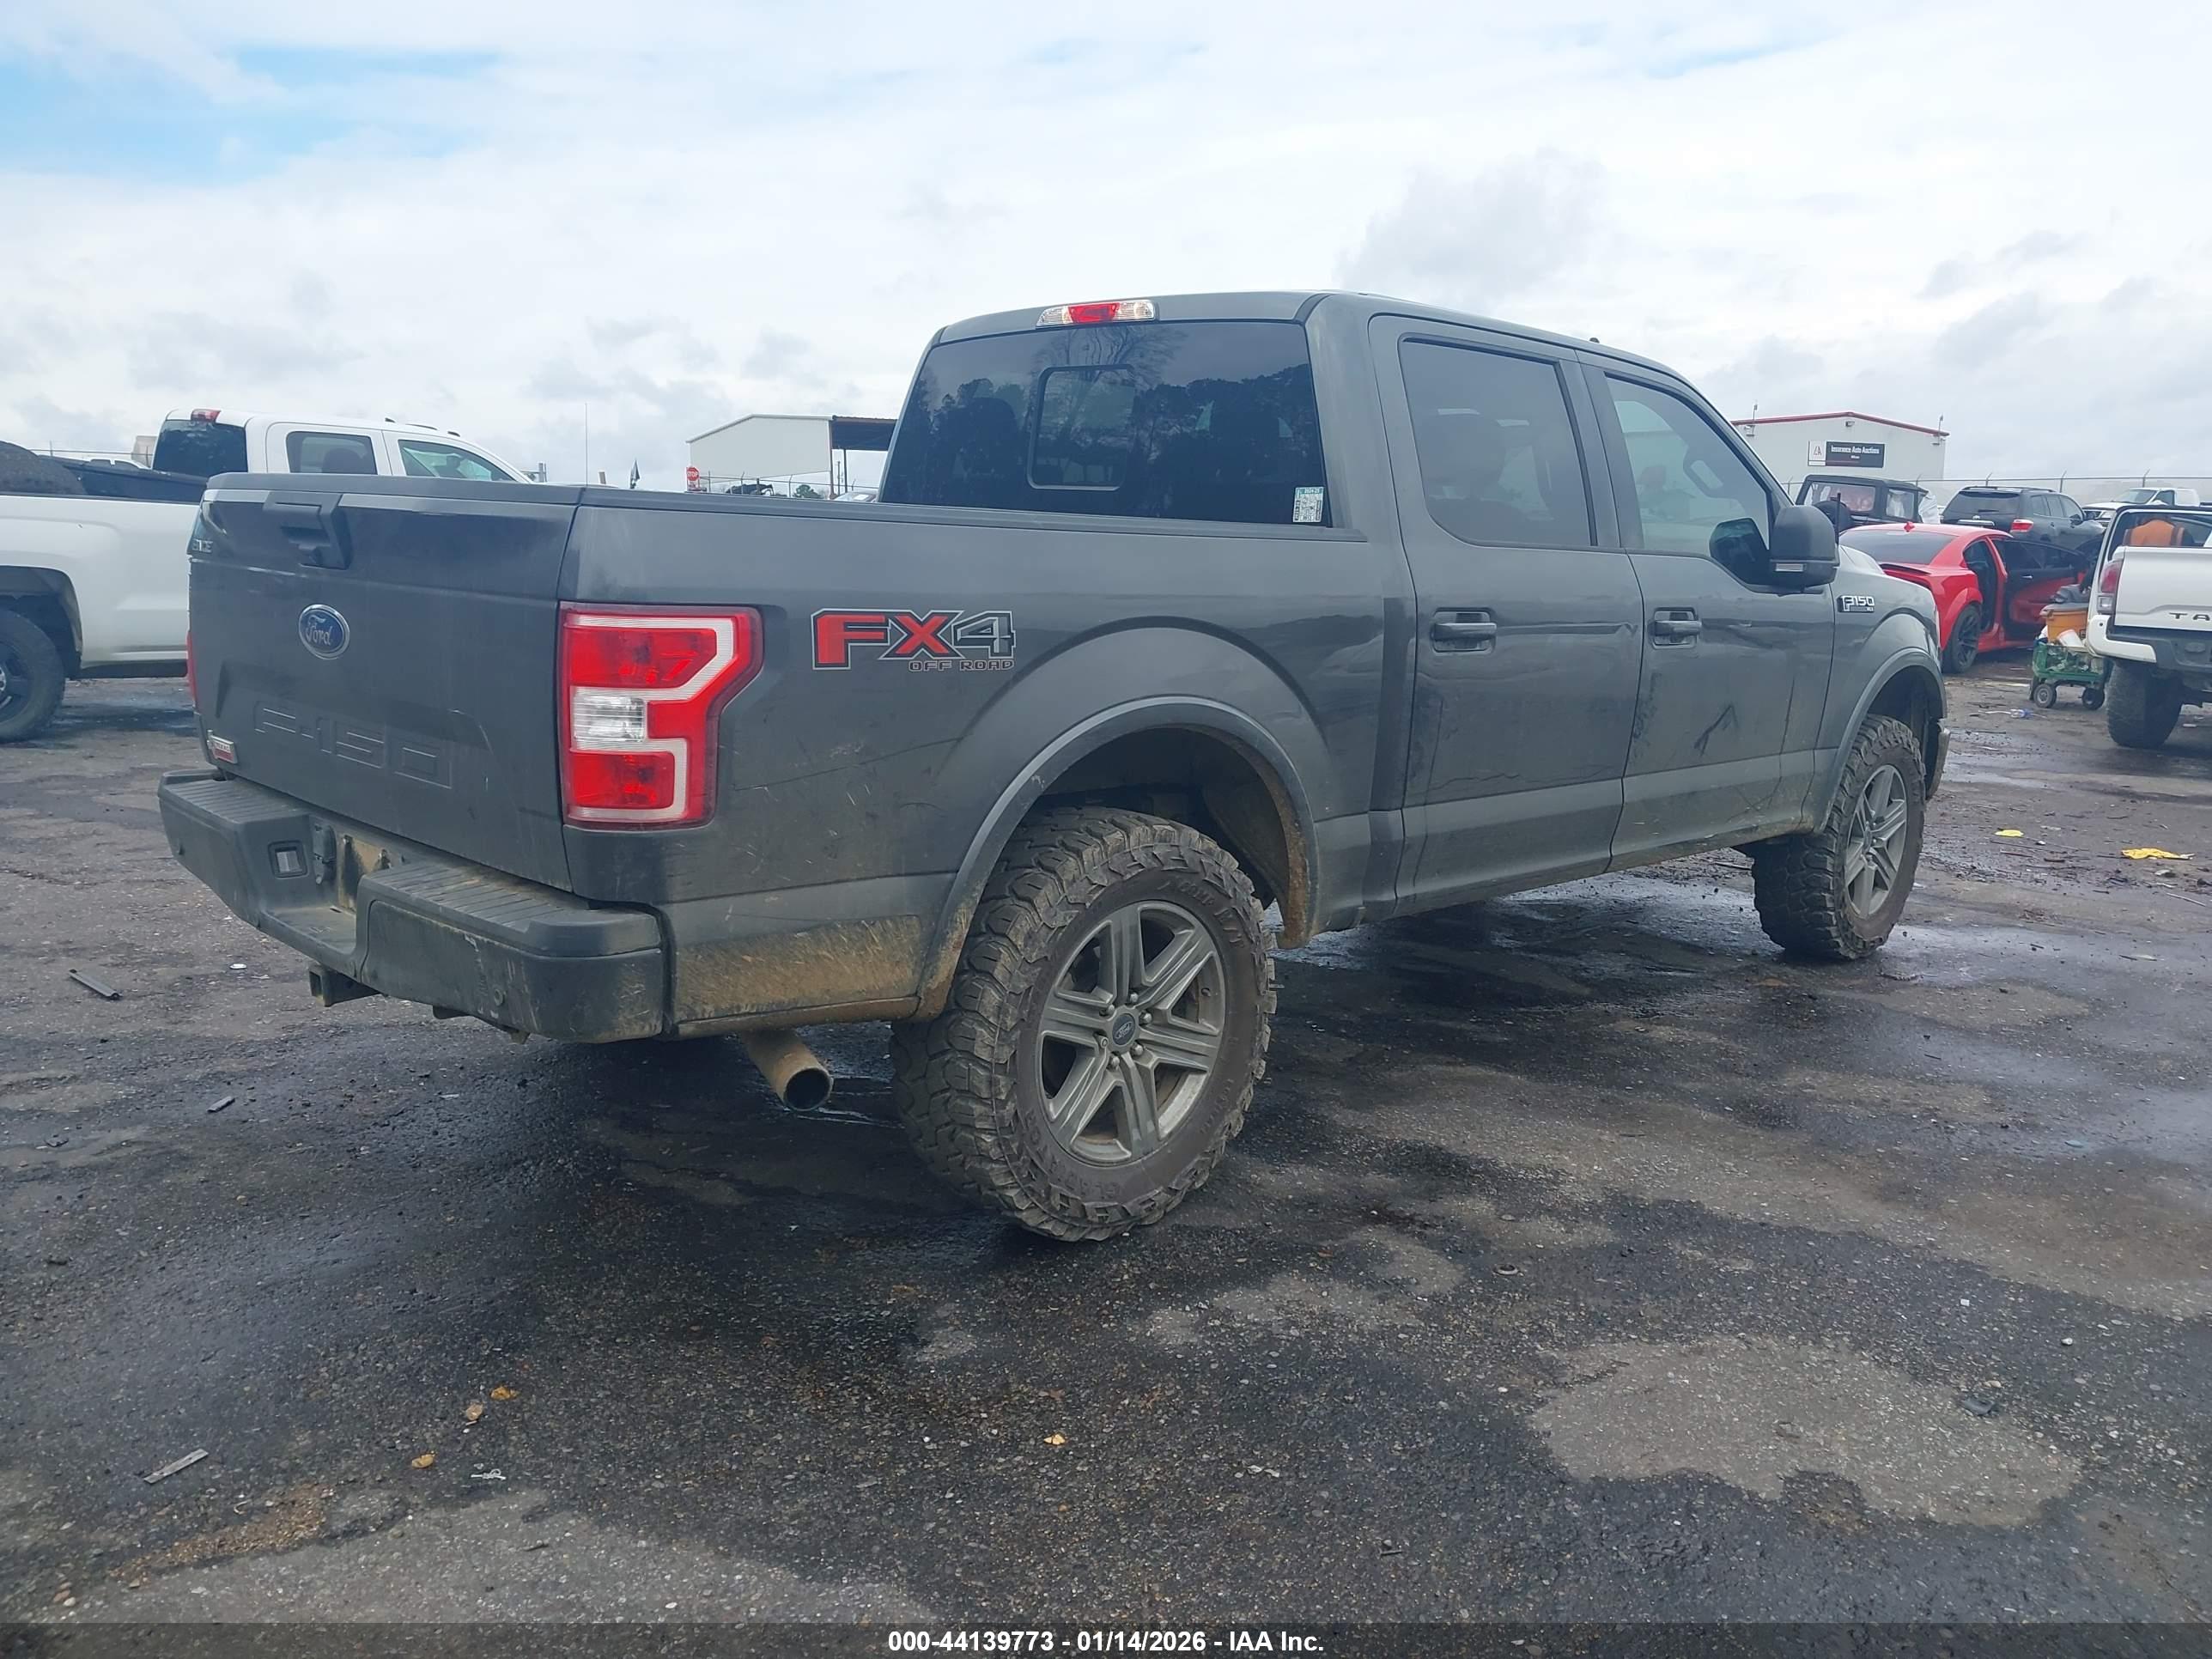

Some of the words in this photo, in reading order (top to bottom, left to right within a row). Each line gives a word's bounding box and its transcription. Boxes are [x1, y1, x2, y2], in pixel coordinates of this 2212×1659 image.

[304, 613, 333, 647] Ford
[811, 607, 1017, 672] FX4
[908, 659, 952, 672] OFF
[959, 659, 1015, 672] ROAD
